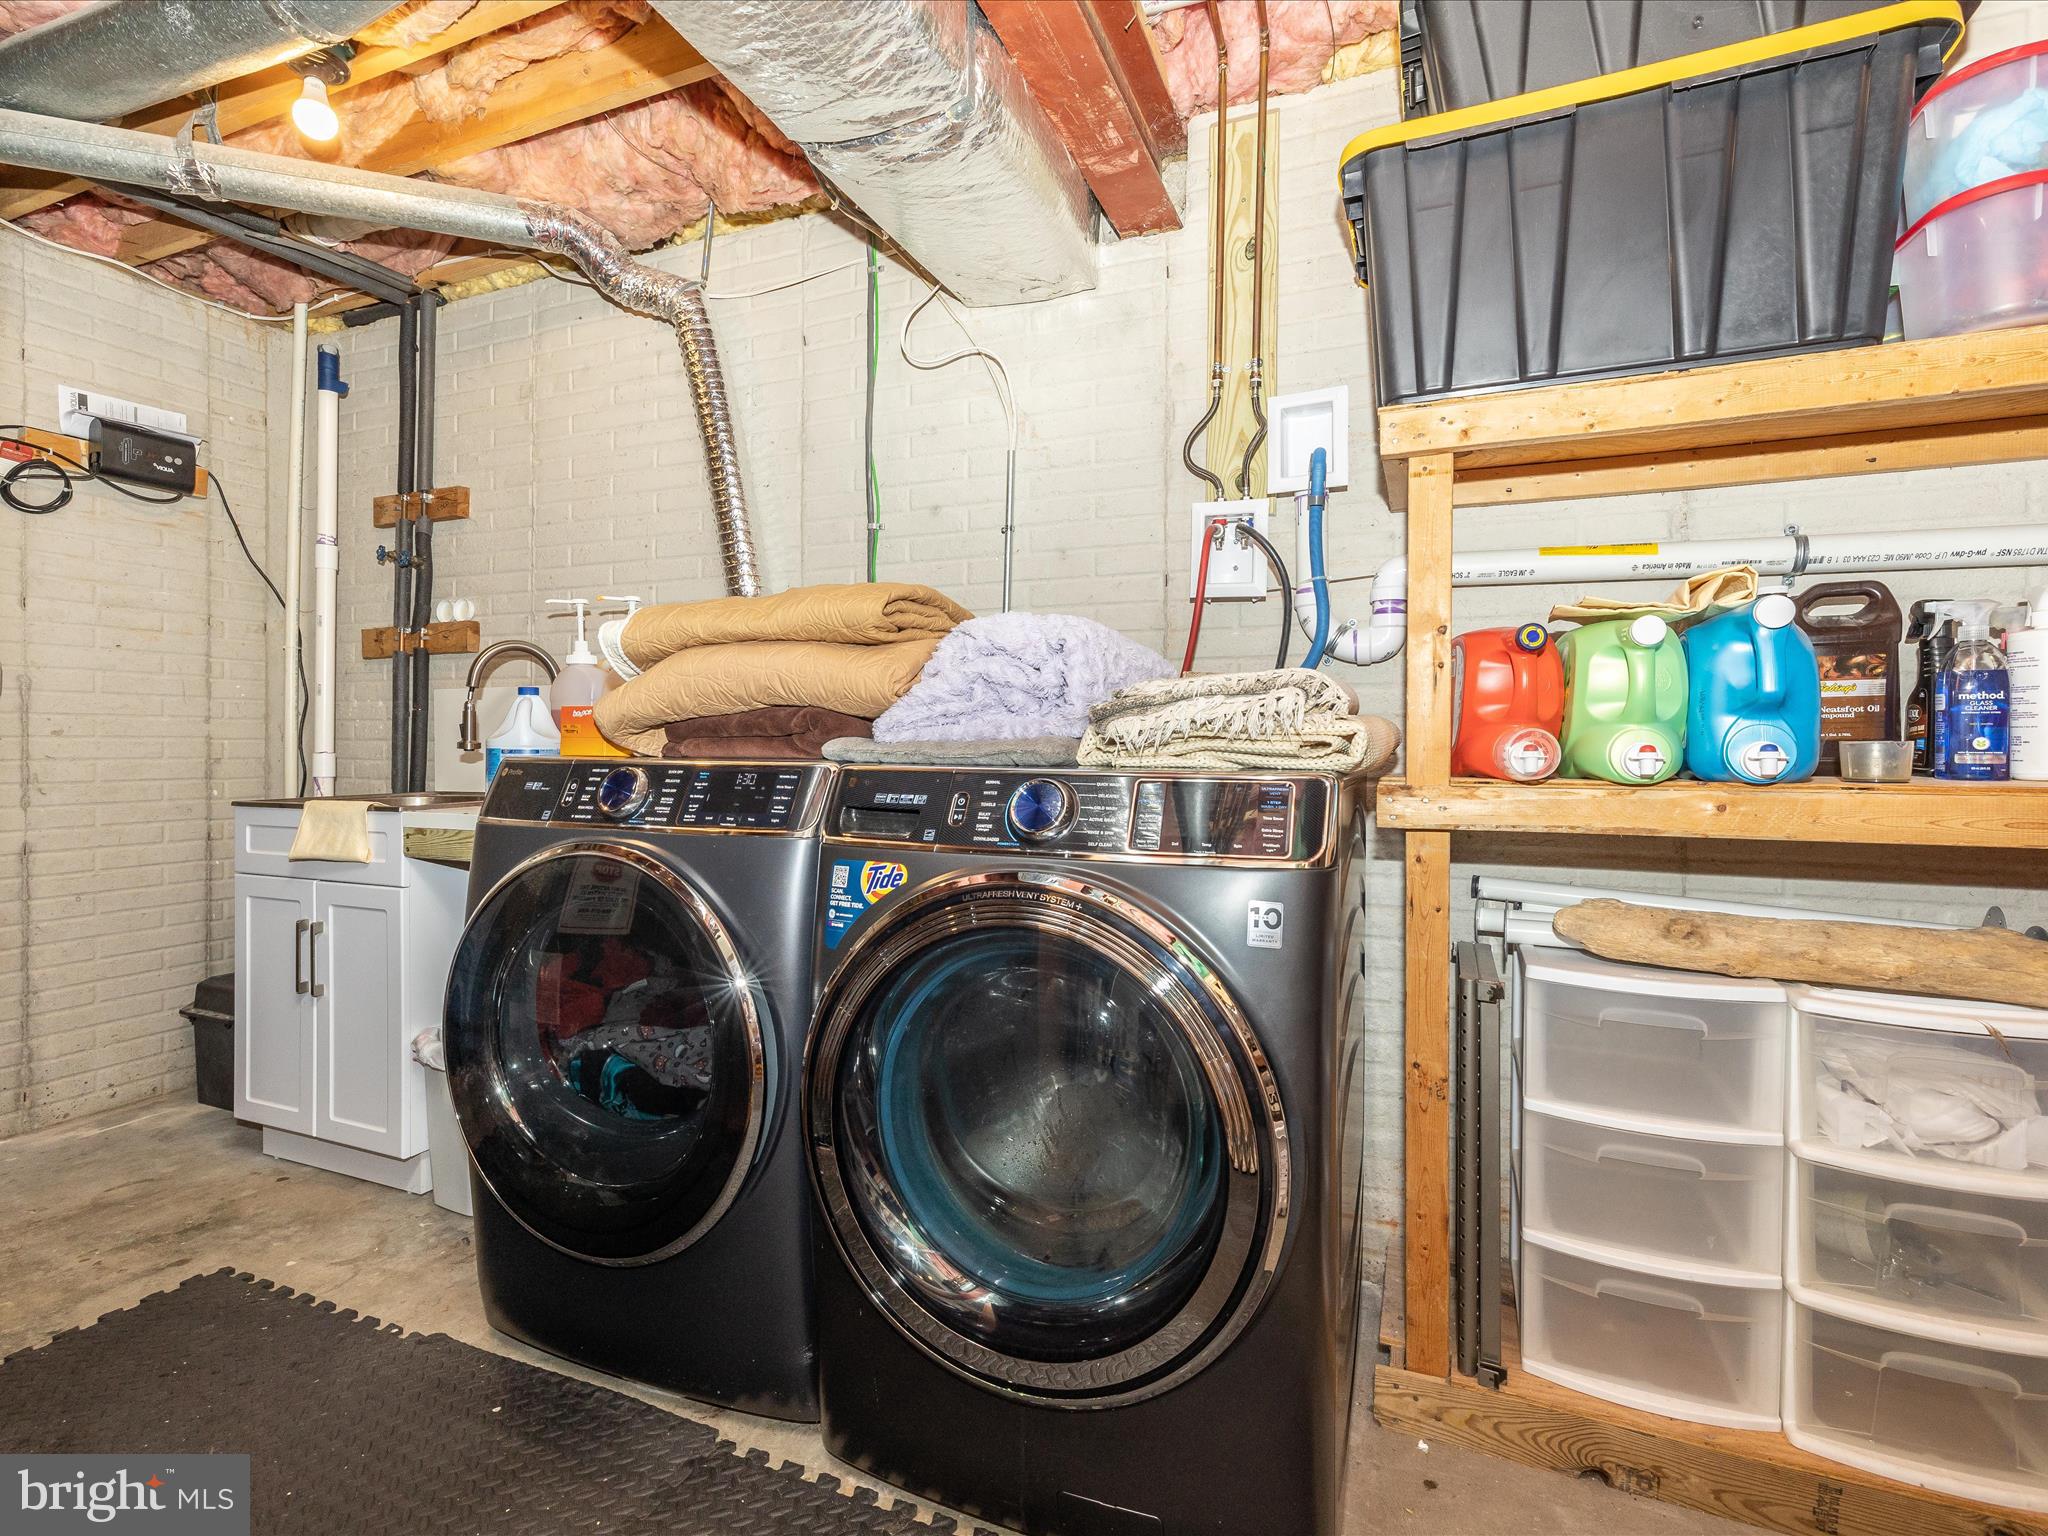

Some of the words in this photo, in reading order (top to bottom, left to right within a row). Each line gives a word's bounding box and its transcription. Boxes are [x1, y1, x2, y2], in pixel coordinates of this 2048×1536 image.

[1996, 548, 2013, 556] NSF
[1498, 570, 1518, 578] EAGLE
[1518, 569, 1528, 577] JM
[1958, 690, 2005, 700] method
[1867, 704, 1880, 712] Oil
[865, 864, 904, 895] Tide
[962, 890, 1015, 901] ULTRAFRESH
[1015, 890, 1040, 900] VENT
[1040, 893, 1075, 909] SYSTEM
[1250, 907, 1282, 930] 10
